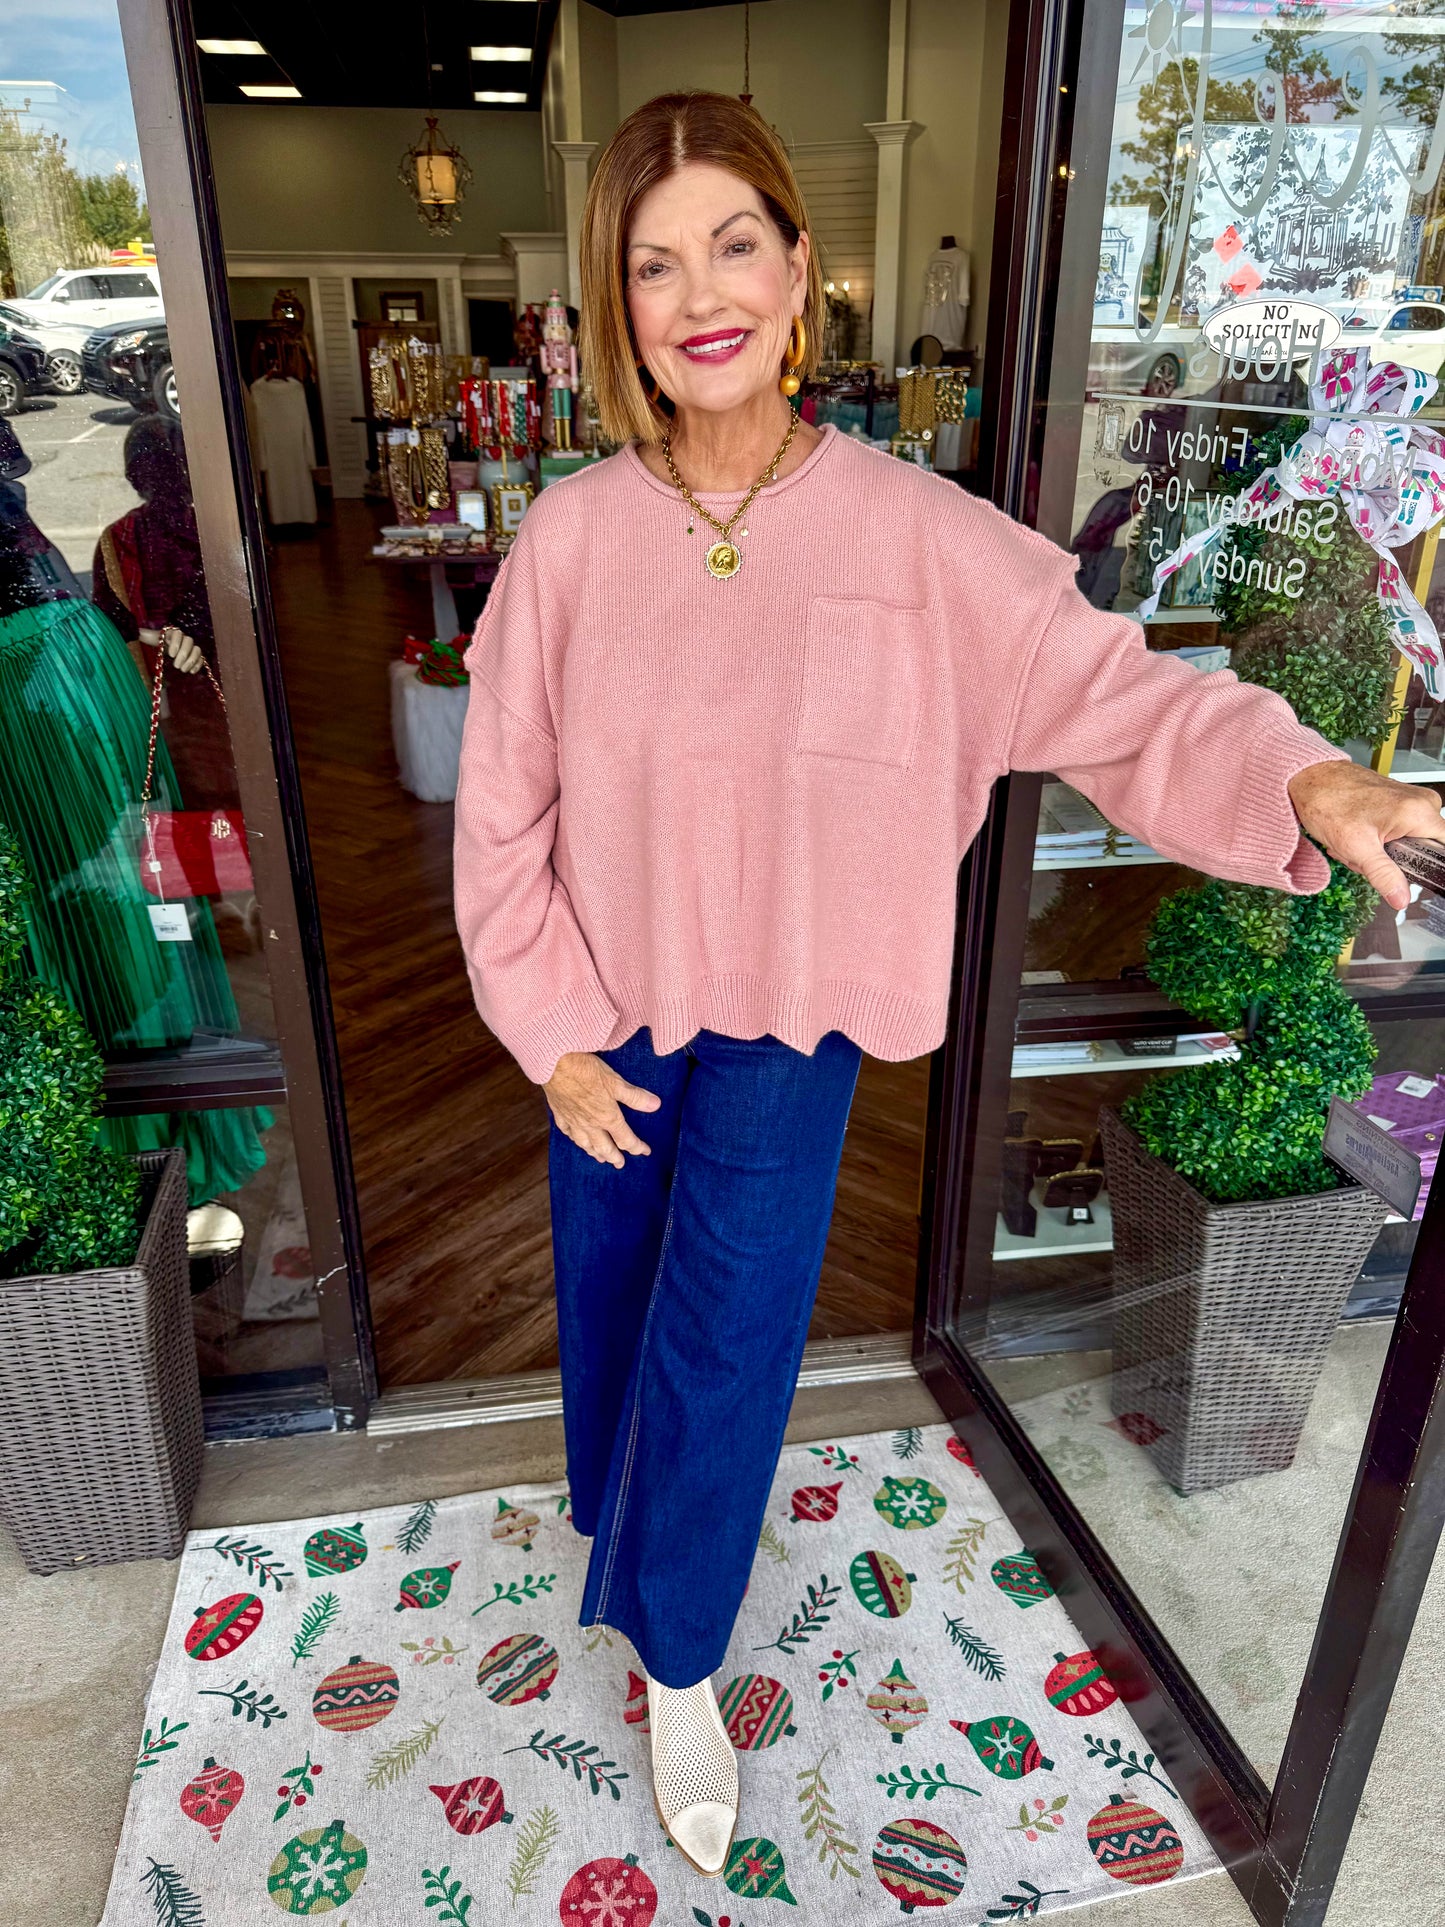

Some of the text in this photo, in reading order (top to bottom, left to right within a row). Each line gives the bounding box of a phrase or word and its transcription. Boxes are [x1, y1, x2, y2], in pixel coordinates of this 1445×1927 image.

[1263, 305, 1289, 320] NO
[1222, 324, 1323, 339] SOLICITN
[1251, 346, 1273, 356] Tank
